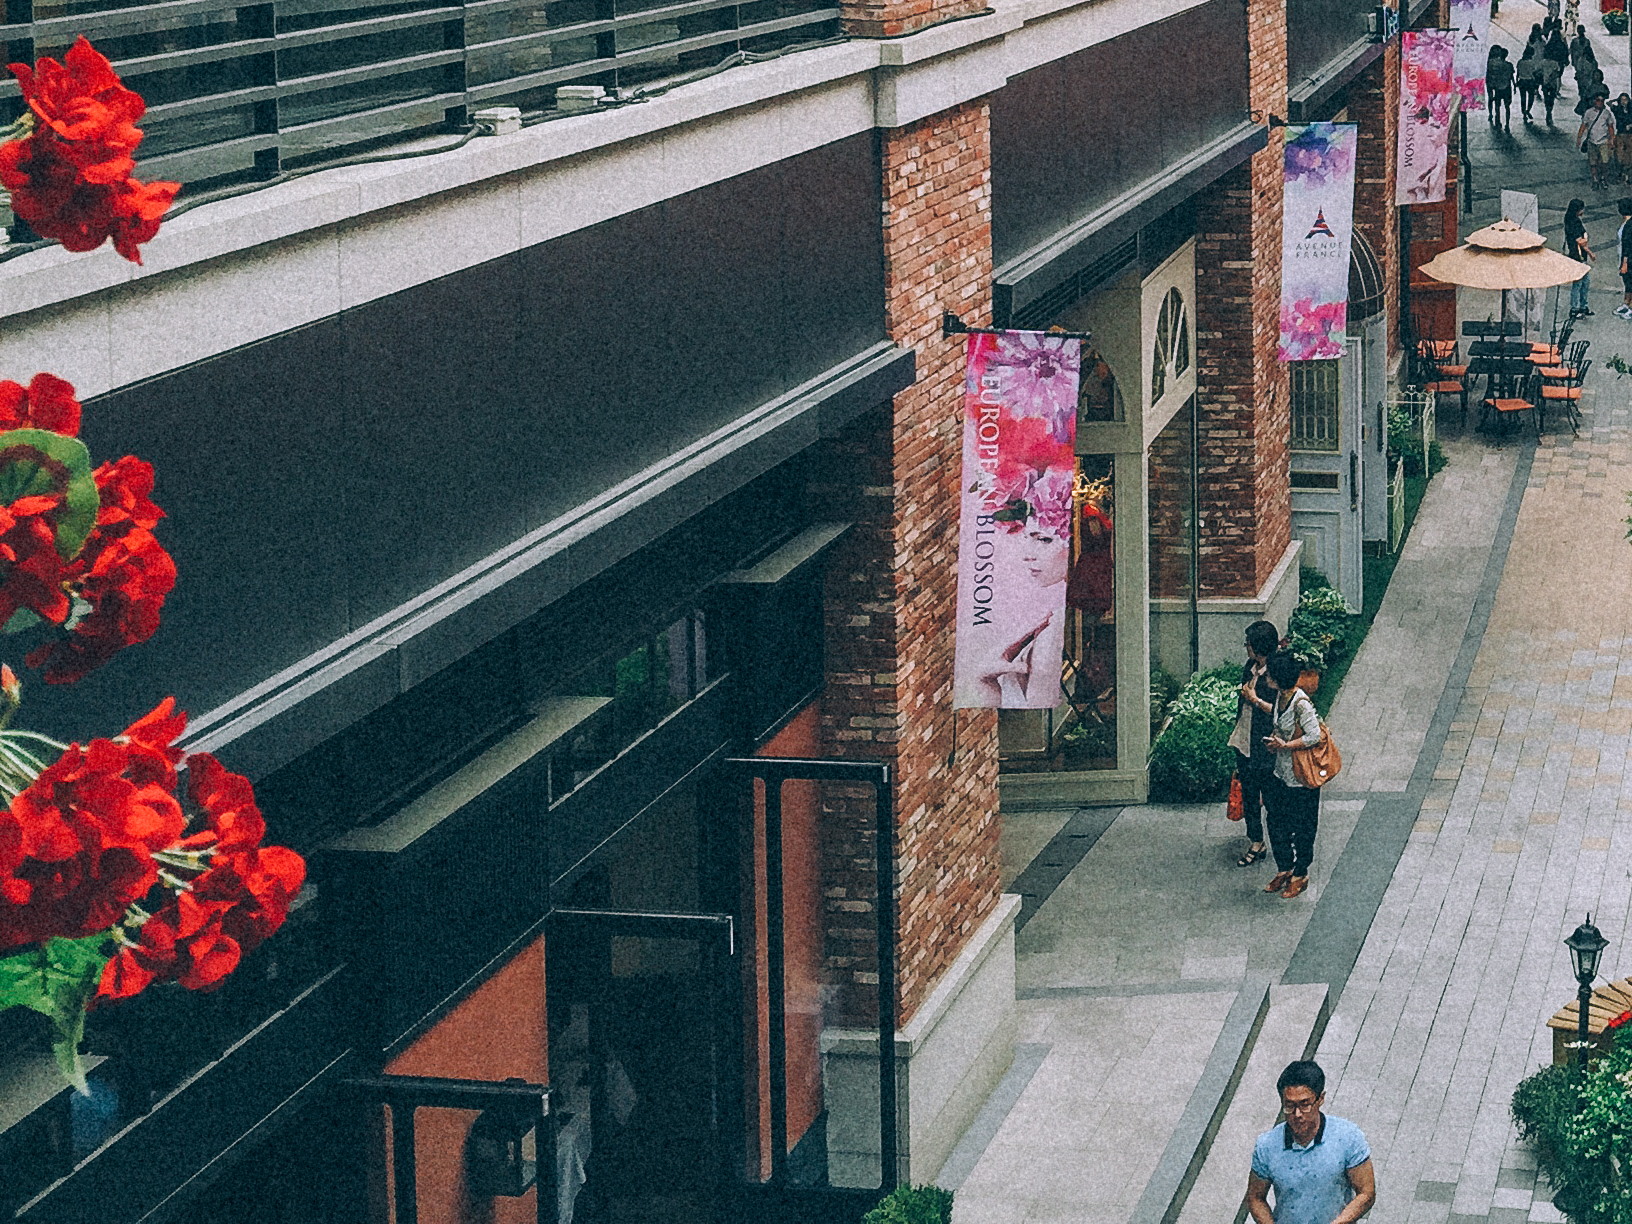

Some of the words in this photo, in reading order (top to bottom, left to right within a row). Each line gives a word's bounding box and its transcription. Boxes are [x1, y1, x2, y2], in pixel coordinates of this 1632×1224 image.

[1404, 115, 1416, 168] BLOSSOM
[1296, 242, 1343, 251] AVENUE
[978, 376, 1000, 511] EUROPEAN
[972, 514, 995, 626] BLOSSOM
